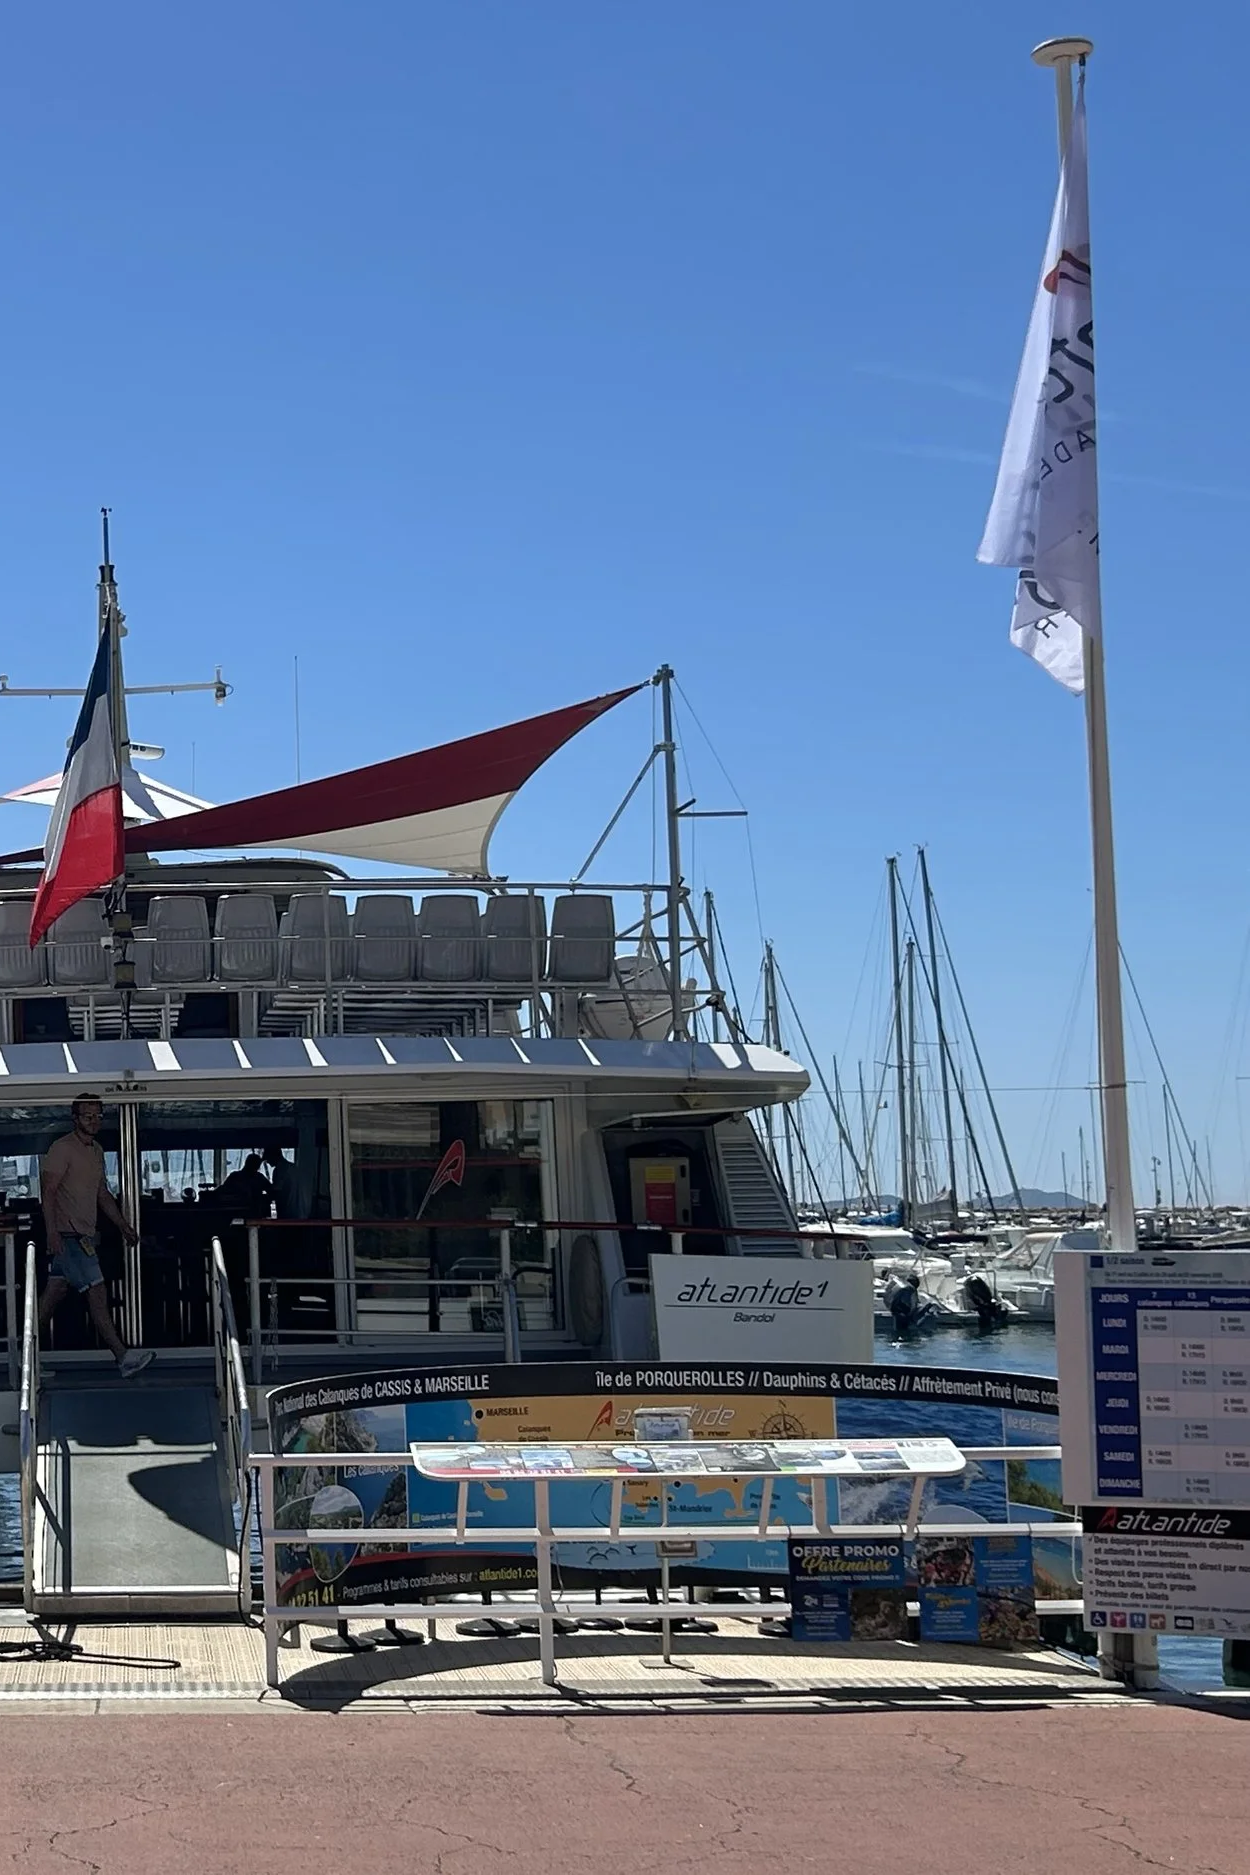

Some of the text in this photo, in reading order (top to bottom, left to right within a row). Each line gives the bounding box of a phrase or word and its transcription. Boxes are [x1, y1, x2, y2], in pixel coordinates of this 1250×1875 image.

[1099, 1293, 1129, 1303] JOURS
[733, 1312, 775, 1323] Bandol
[305, 1392, 318, 1408] des
[318, 1388, 359, 1406] Calanques
[361, 1383, 373, 1399] de
[375, 1378, 411, 1398] CASSIS
[413, 1379, 423, 1394] &
[425, 1374, 490, 1393] MARSEILLE
[615, 1372, 632, 1387] de
[636, 1370, 745, 1388] PORQUEROLLES
[763, 1370, 827, 1390] Dauphins
[830, 1373, 841, 1388] &
[844, 1371, 896, 1391] Cétacés
[912, 1375, 983, 1397] Affrètement
[985, 1382, 1012, 1400] Privé
[486, 1407, 529, 1417] MARSEILLE
[668, 1503, 712, 1512] St-Mandrier
[1117, 1510, 1231, 1534] atlantide
[1094, 1535, 1244, 1551] Des équipages professionnels diplômés
[793, 1545, 900, 1558] OFFRE PROMO
[1094, 1547, 1102, 1555] et
[801, 1555, 890, 1574] Partenaires
[1094, 1558, 1109, 1566] Des
[1110, 1559, 1135, 1567] visites
[1137, 1560, 1186, 1569] commentées
[1199, 1562, 1222, 1571] direct
[1223, 1565, 1236, 1573] par
[1094, 1568, 1126, 1578] Respect
[1127, 1570, 1141, 1578] des
[322, 1584, 334, 1604] 41
[343, 1581, 382, 1600] Programmes
[410, 1573, 458, 1588] consultables
[460, 1572, 473, 1584] sur
[479, 1567, 538, 1582] atlantide1.co
[1095, 1579, 1116, 1588] Tarifs
[1147, 1581, 1168, 1590] tarifs
[1130, 1592, 1144, 1600] des
[1145, 1592, 1169, 1601] billets
